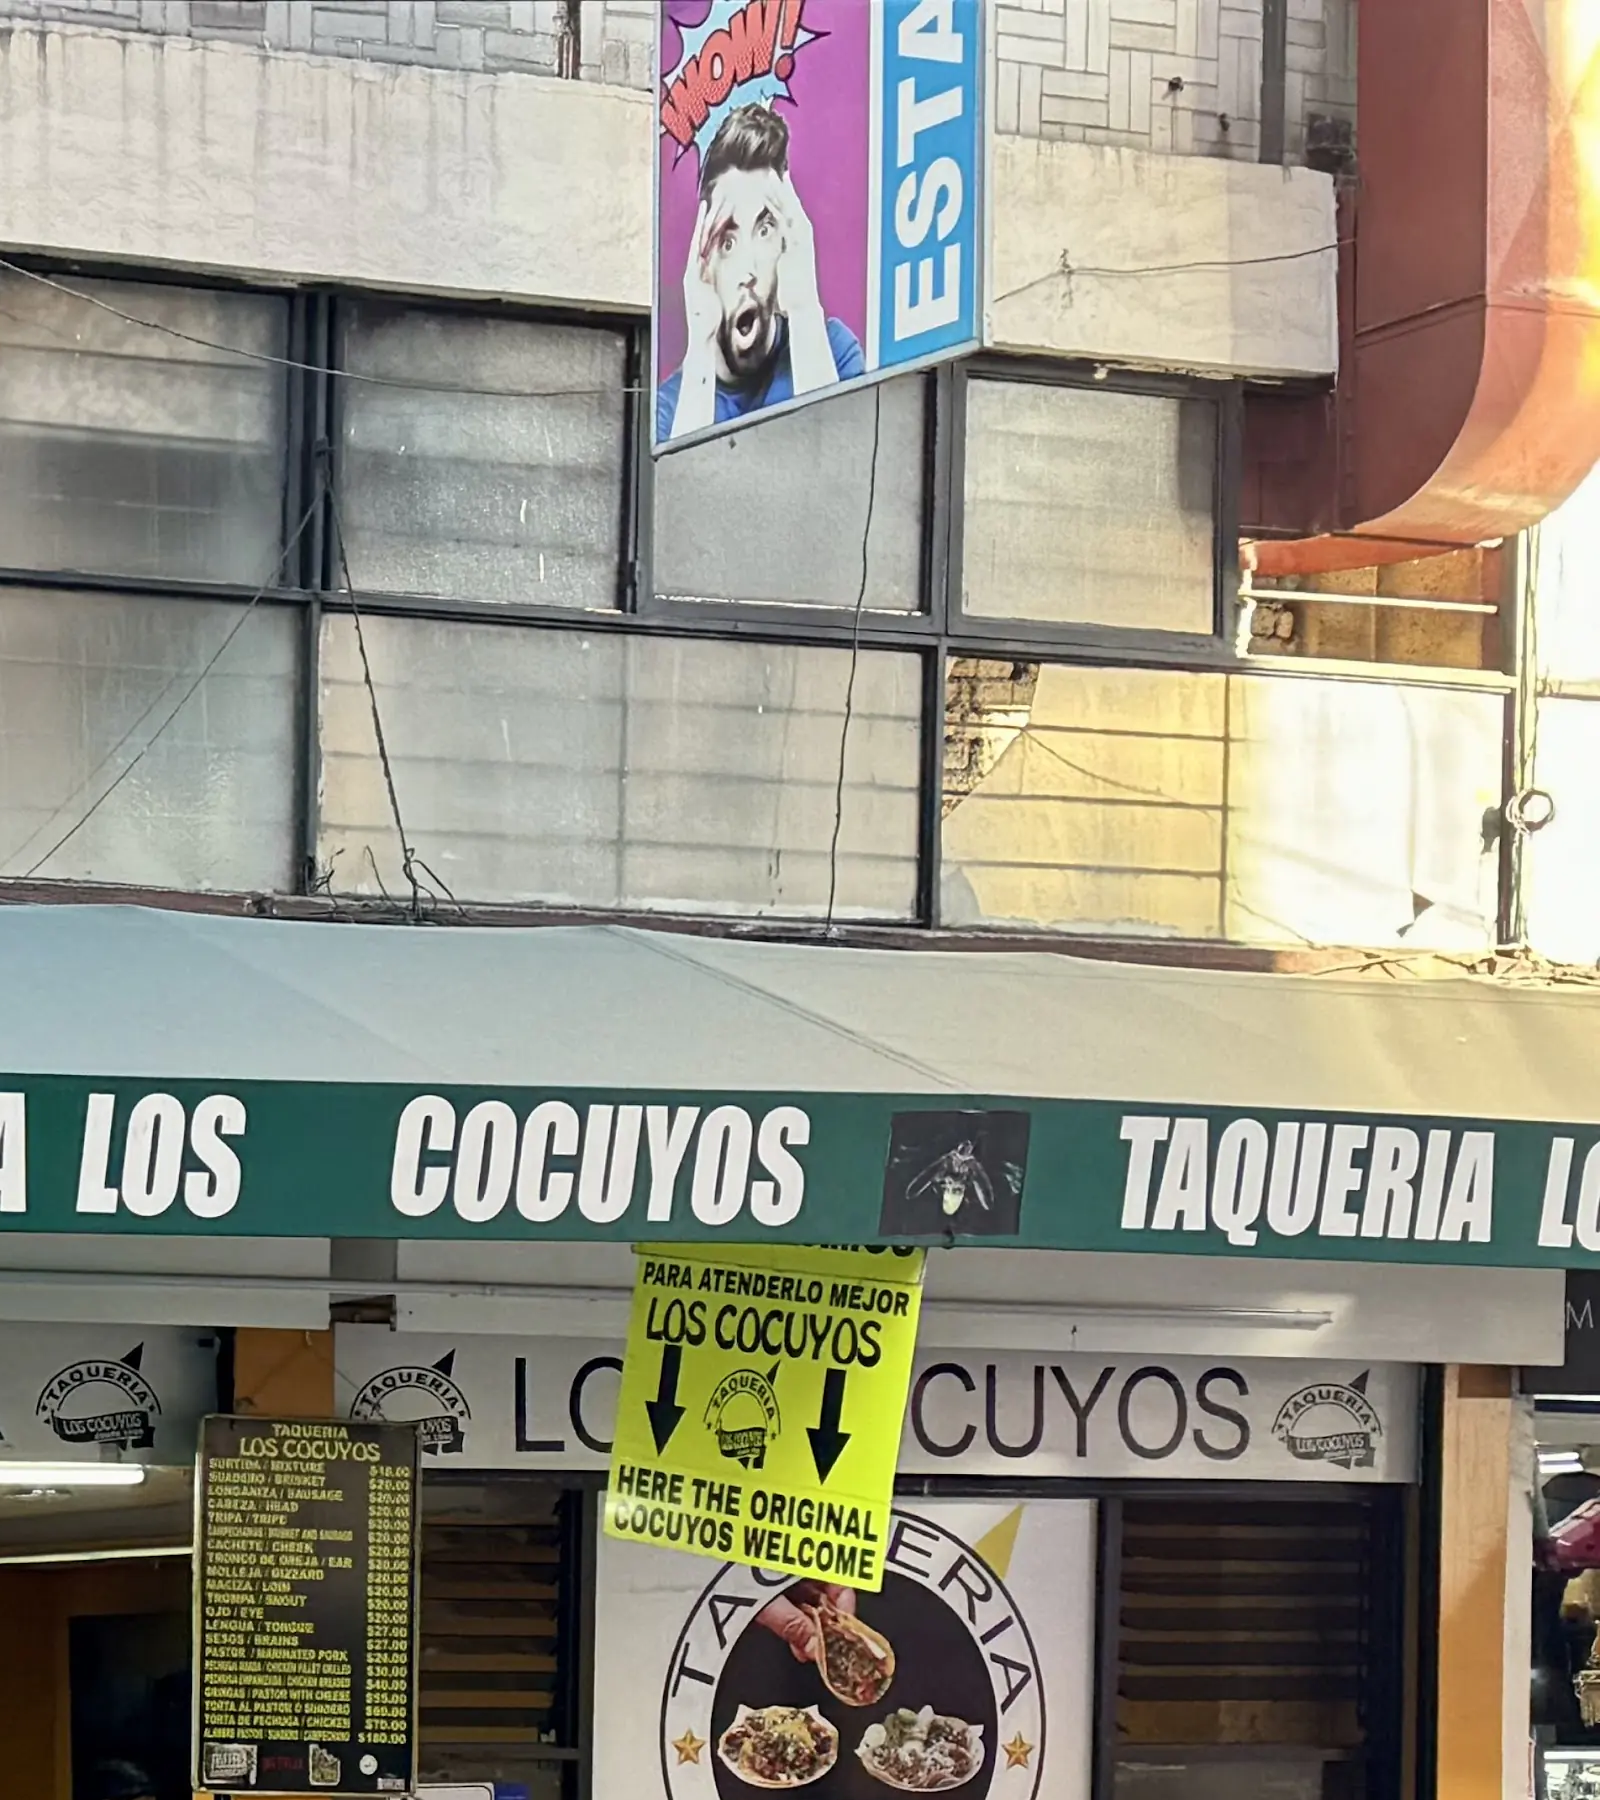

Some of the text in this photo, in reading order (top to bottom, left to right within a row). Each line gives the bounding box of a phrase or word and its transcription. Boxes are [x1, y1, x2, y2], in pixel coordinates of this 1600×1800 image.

[661, 0, 804, 147] WOW!
[76, 1091, 247, 1218] LOS
[391, 1094, 810, 1227] COCUYOS
[1119, 1116, 1497, 1245] TAQUERIA
[642, 1261, 910, 1317] PARA ATENDERLO MEJOR
[646, 1297, 882, 1368] LOS COCUYOS
[46, 1365, 149, 1404] TAQUERIA
[360, 1372, 460, 1409] TAQUERIA
[514, 1356, 1250, 1462] LO CUYOS
[712, 1375, 775, 1420] TAQUERIA
[1282, 1389, 1371, 1424] TAQUERIA
[240, 1437, 380, 1462] LOS COCUYOS
[272, 1423, 348, 1439] TAQUERIA
[617, 1464, 879, 1543] HERE THE ORIGINAL
[614, 1503, 876, 1581] COCUYOS WELCOME
[240, 1607, 264, 1619] EYE
[671, 1519, 1037, 1717] TAERIA
